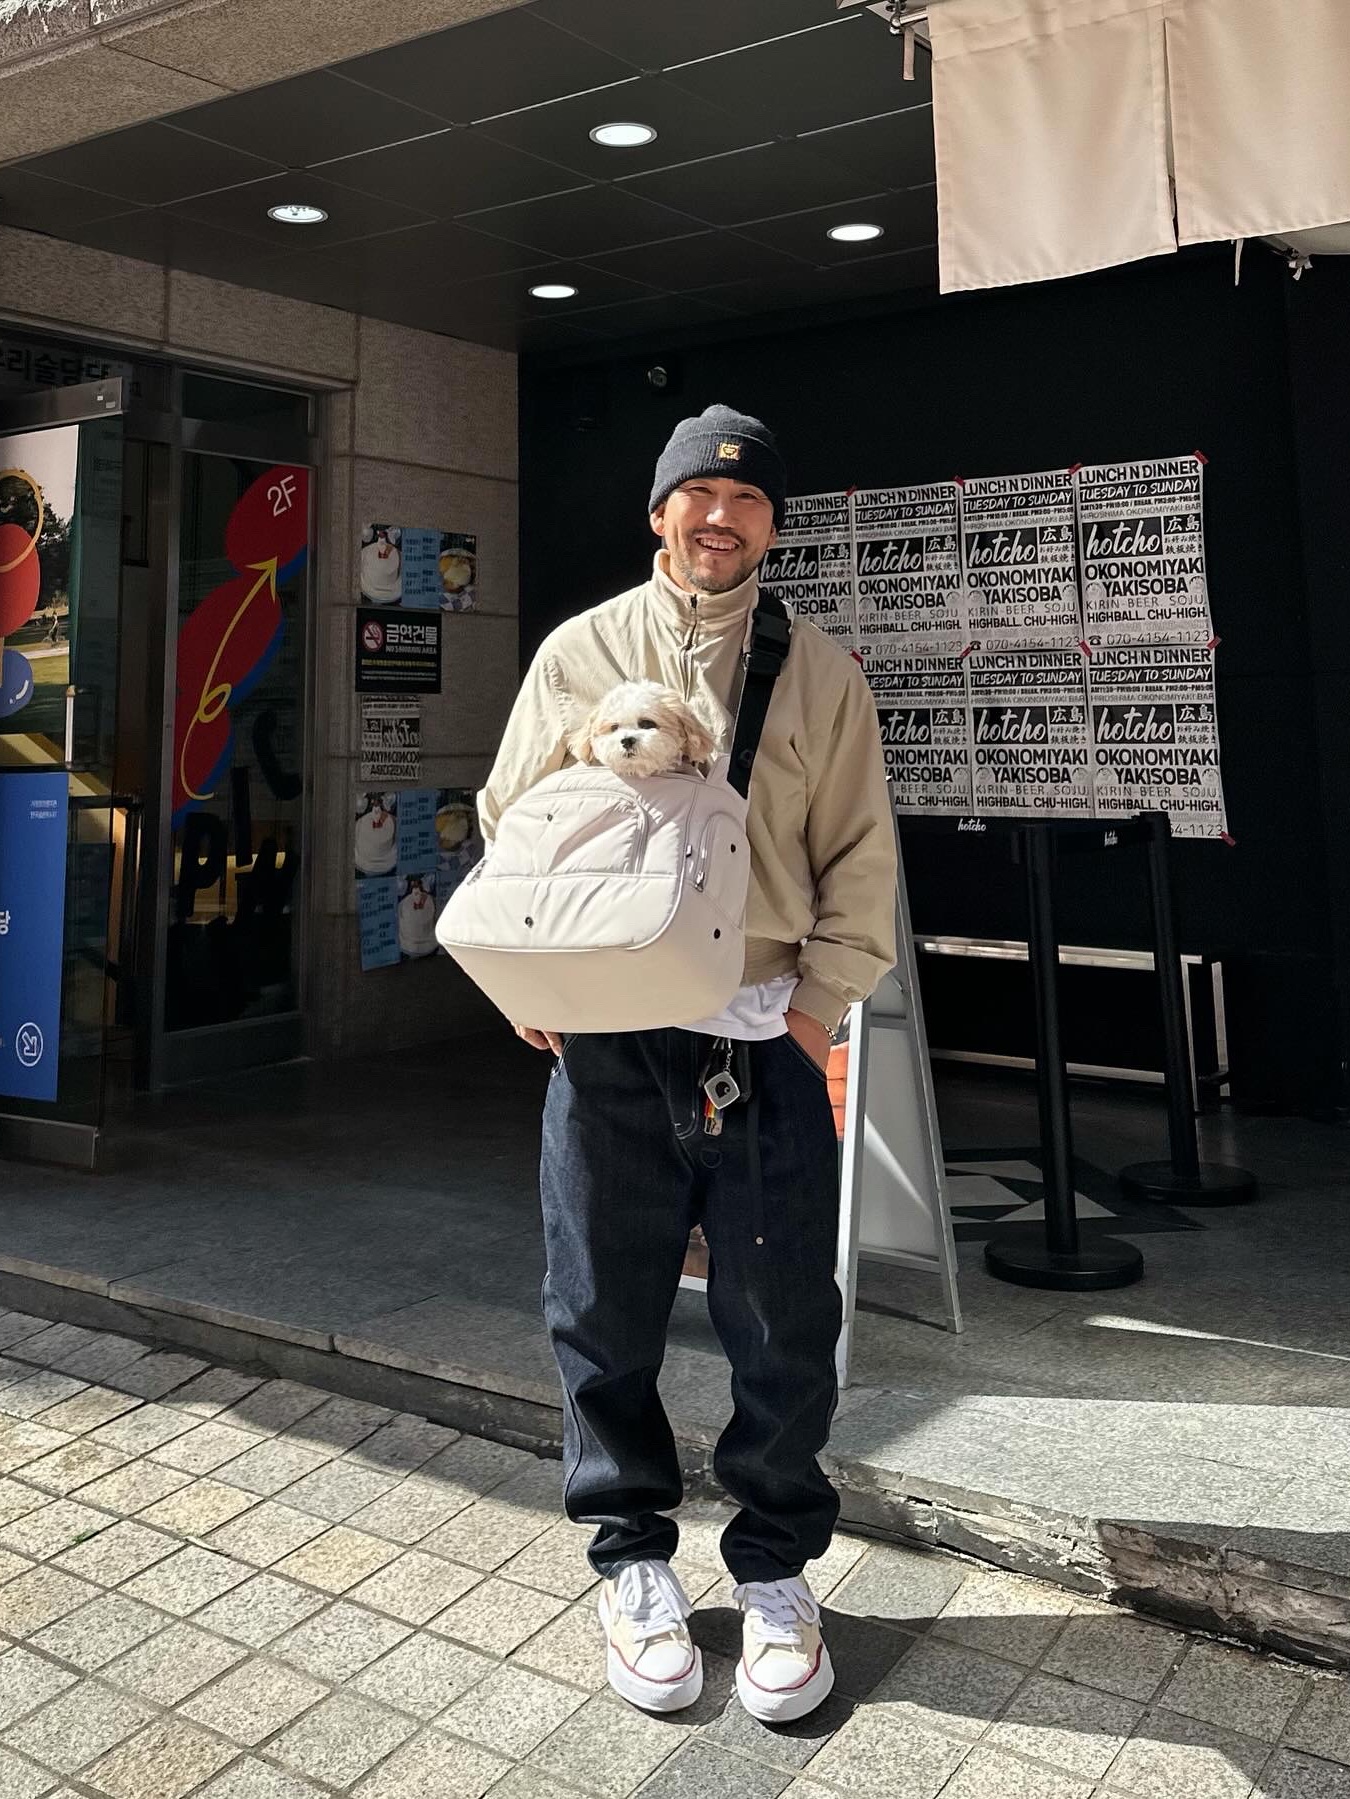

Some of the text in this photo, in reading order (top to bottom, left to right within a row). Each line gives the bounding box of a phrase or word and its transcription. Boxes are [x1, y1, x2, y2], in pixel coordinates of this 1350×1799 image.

[1079, 460, 1198, 484] LUNCH N DINNER
[963, 474, 1072, 496] LUNCH N DINNER
[1081, 480, 1198, 501] TUESDAY TO SUNDAY
[267, 475, 297, 517] 2F
[796, 501, 803, 512] N
[806, 496, 848, 511] DINNER
[855, 486, 956, 506] LUNCH N DINNER
[964, 492, 1071, 512] TUESDAY TO SUNDAY
[856, 503, 955, 522] TUESDAY TO SUNDAY
[1185, 503, 1200, 511] BAR
[798, 516, 809, 526] TO
[811, 513, 848, 525] SUNDAY
[1167, 514, 1199, 532] 広島
[1042, 526, 1072, 542] 広島
[1087, 521, 1160, 558] hotcho
[822, 544, 849, 559] 広島
[927, 536, 955, 551] 広島
[969, 530, 1035, 567] hotcho
[760, 549, 817, 582] hotcho
[860, 540, 921, 575] hotcho
[967, 567, 1075, 587] OKONOMIYAKI
[1085, 557, 1203, 580] OKONOMIYAKI
[859, 574, 959, 595] OKONOMIYAKI
[1103, 577, 1188, 597] YAKISOBA
[873, 593, 945, 611] YAKISOBA
[983, 586, 1062, 604] YAKISOBA
[386, 624, 437, 645] 금연건물
[986, 636, 1080, 650] 070-4154-1123
[1107, 630, 1209, 645] 070-4154-1123
[876, 641, 962, 654] 070-4154-1123
[861, 657, 963, 672] LUNCH N DINNER
[970, 653, 1081, 669] LUNCH N DINNER
[1090, 649, 1211, 665] LUNCH N DINNER
[868, 675, 963, 688] UESDAY TO SUNDAY
[971, 672, 1081, 685] TUESDAY TO SUNDAY
[1090, 667, 1211, 682] TUESDAY TO SUNDAY
[935, 709, 964, 724] 広島
[1051, 706, 1083, 723] 広島
[1179, 704, 1213, 722] 広島
[881, 711, 929, 743] otcho
[977, 709, 1046, 743] hotcho
[1097, 707, 1172, 742] hotcho
[884, 749, 968, 765] ONOMIYAKI
[976, 749, 1087, 764] OKONOMIYAKI
[1095, 749, 1218, 765] OKONOMIYAKI
[887, 767, 953, 782] AKISOBA
[992, 767, 1072, 783] YAKISOBA
[1114, 768, 1201, 784] YAKISOBA
[958, 818, 986, 831] hotcho
